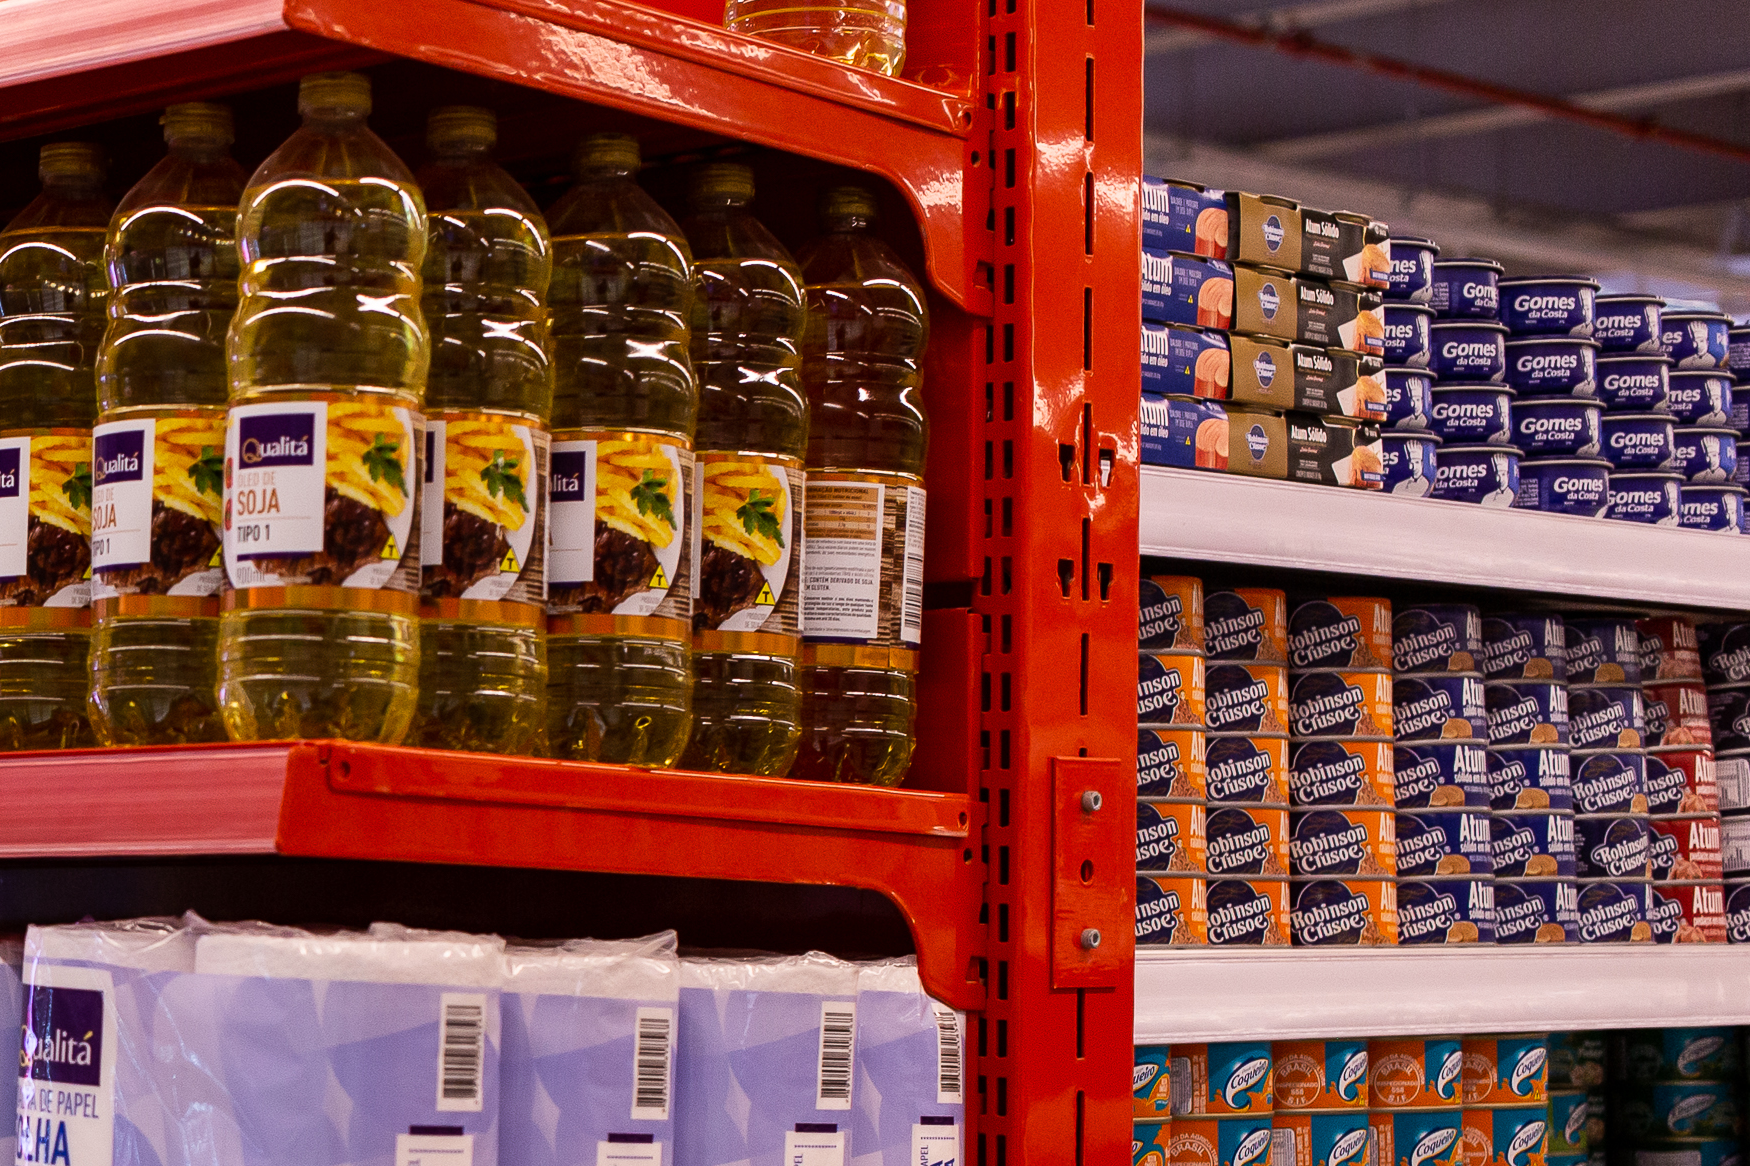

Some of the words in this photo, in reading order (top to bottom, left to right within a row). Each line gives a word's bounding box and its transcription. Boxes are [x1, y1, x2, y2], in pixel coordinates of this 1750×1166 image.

[1305, 219, 1320, 234] Atum
[1321, 219, 1339, 239] Sólido
[1514, 295, 1575, 311] Gomes
[1529, 310, 1540, 318] da
[1543, 310, 1568, 319] Costa
[1443, 342, 1496, 358] Gomes
[1517, 355, 1577, 371] Gomes
[1532, 370, 1543, 378] da
[1545, 369, 1570, 377] Costa
[1432, 404, 1494, 419] Gomes
[1291, 426, 1307, 440] Atum
[1308, 425, 1327, 442] Sólido
[1520, 418, 1582, 433] Gomes
[242, 436, 309, 463] Qualitá
[1610, 432, 1664, 447] Gomes
[96, 452, 138, 480] Qualitá
[263, 472, 275, 485] DE
[238, 488, 280, 516] SOJA
[93, 504, 116, 530] SOJA
[238, 525, 260, 542] TIPO
[265, 524, 270, 540] 1
[107, 539, 110, 553] 1
[388, 545, 394, 557] T
[1573, 767, 1635, 801] Robinson
[1585, 785, 1633, 812] Crusoe
[1290, 826, 1367, 859] Robinson
[1689, 822, 1719, 849] Atum
[1301, 844, 1363, 871] Crusoe
[1291, 896, 1367, 930] Robinson
[1209, 915, 1267, 943] Crusoe
[1303, 914, 1364, 942] Crusoe
[1231, 1061, 1268, 1090] Coqueiro
[1281, 1062, 1313, 1077] BRASIL
[1172, 1142, 1205, 1157] BRASIL
[1238, 1132, 1270, 1160] Coqueiro
[1417, 1129, 1456, 1158] Coqueiro
